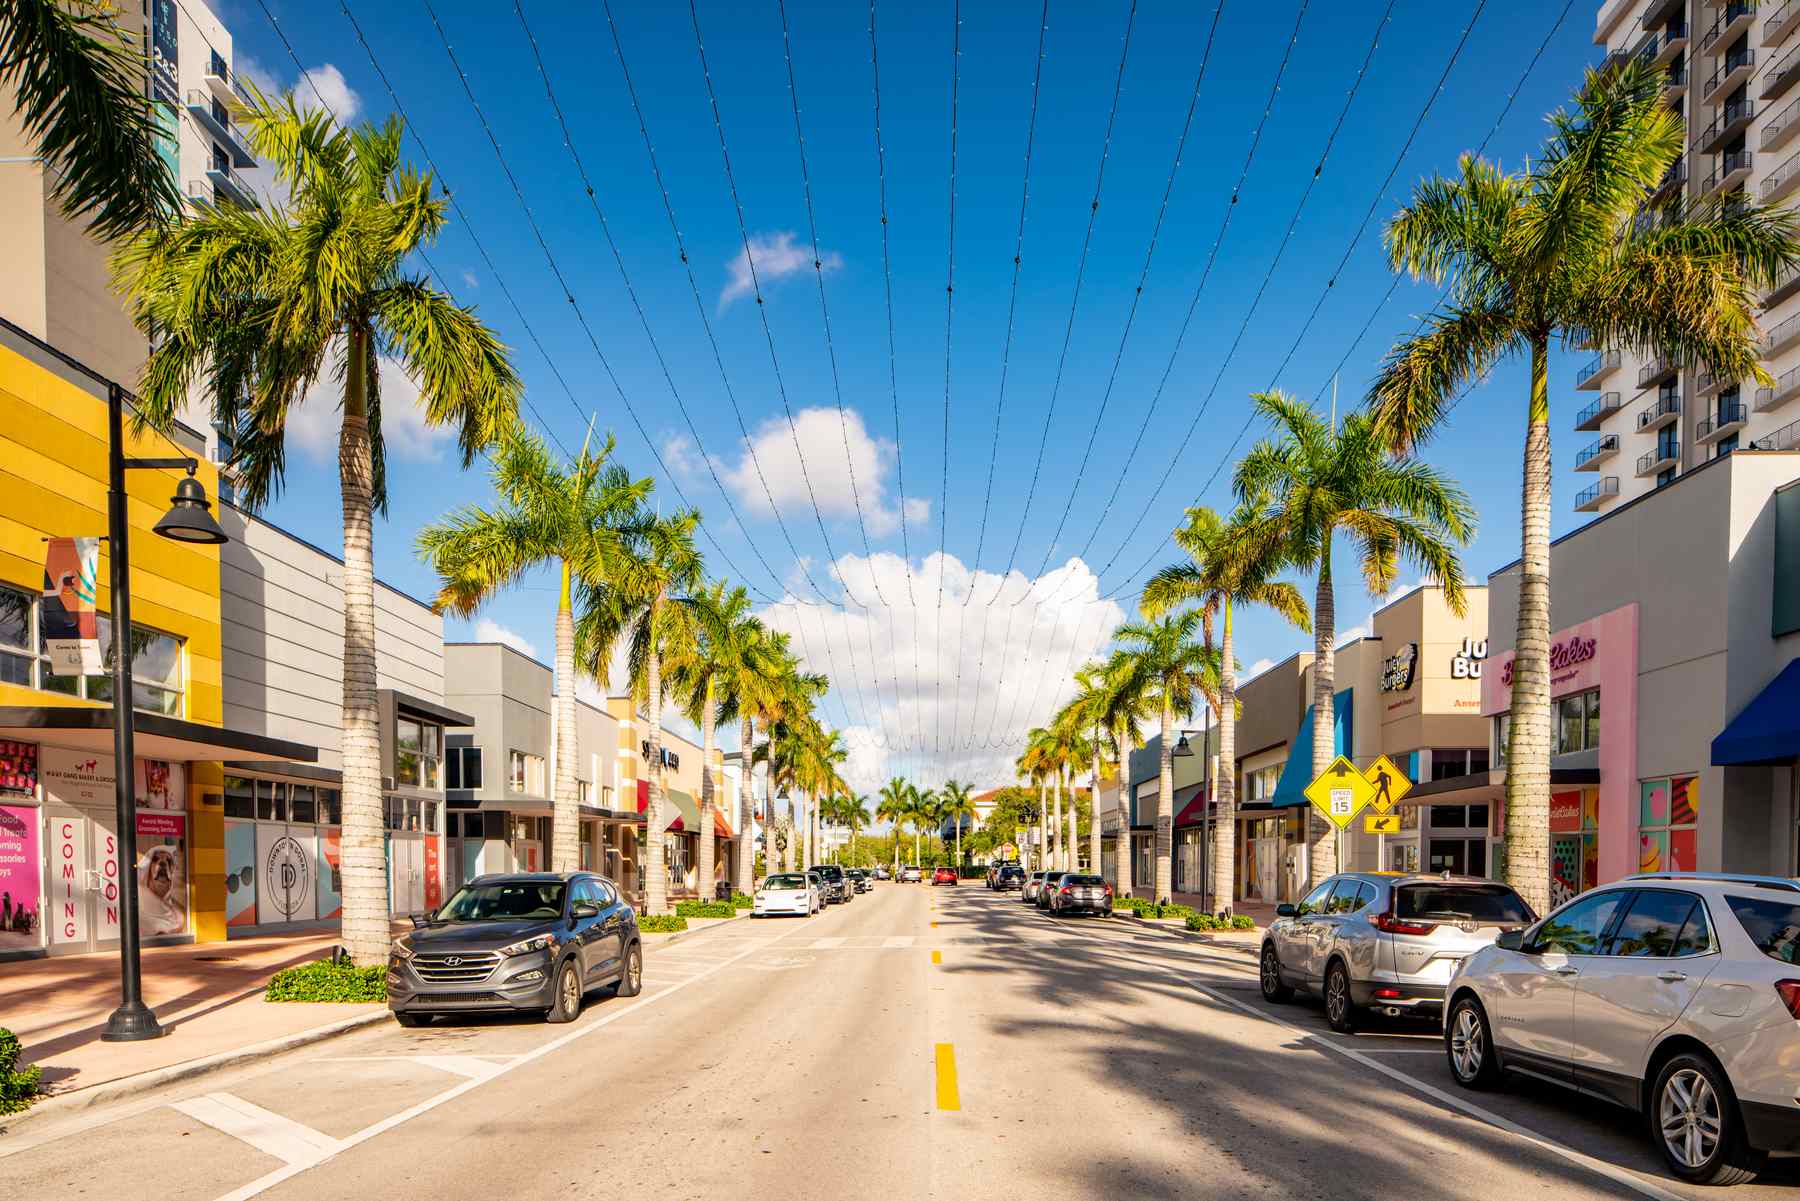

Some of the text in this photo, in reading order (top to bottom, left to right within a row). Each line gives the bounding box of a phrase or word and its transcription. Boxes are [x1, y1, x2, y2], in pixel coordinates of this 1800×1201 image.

[1457, 637, 1488, 659] Ju
[1452, 656, 1482, 680] Bu
[1381, 670, 1408, 691] Burgers
[1335, 801, 1349, 812] 15
[62, 823, 76, 938] COMING
[104, 836, 118, 925] SOON
